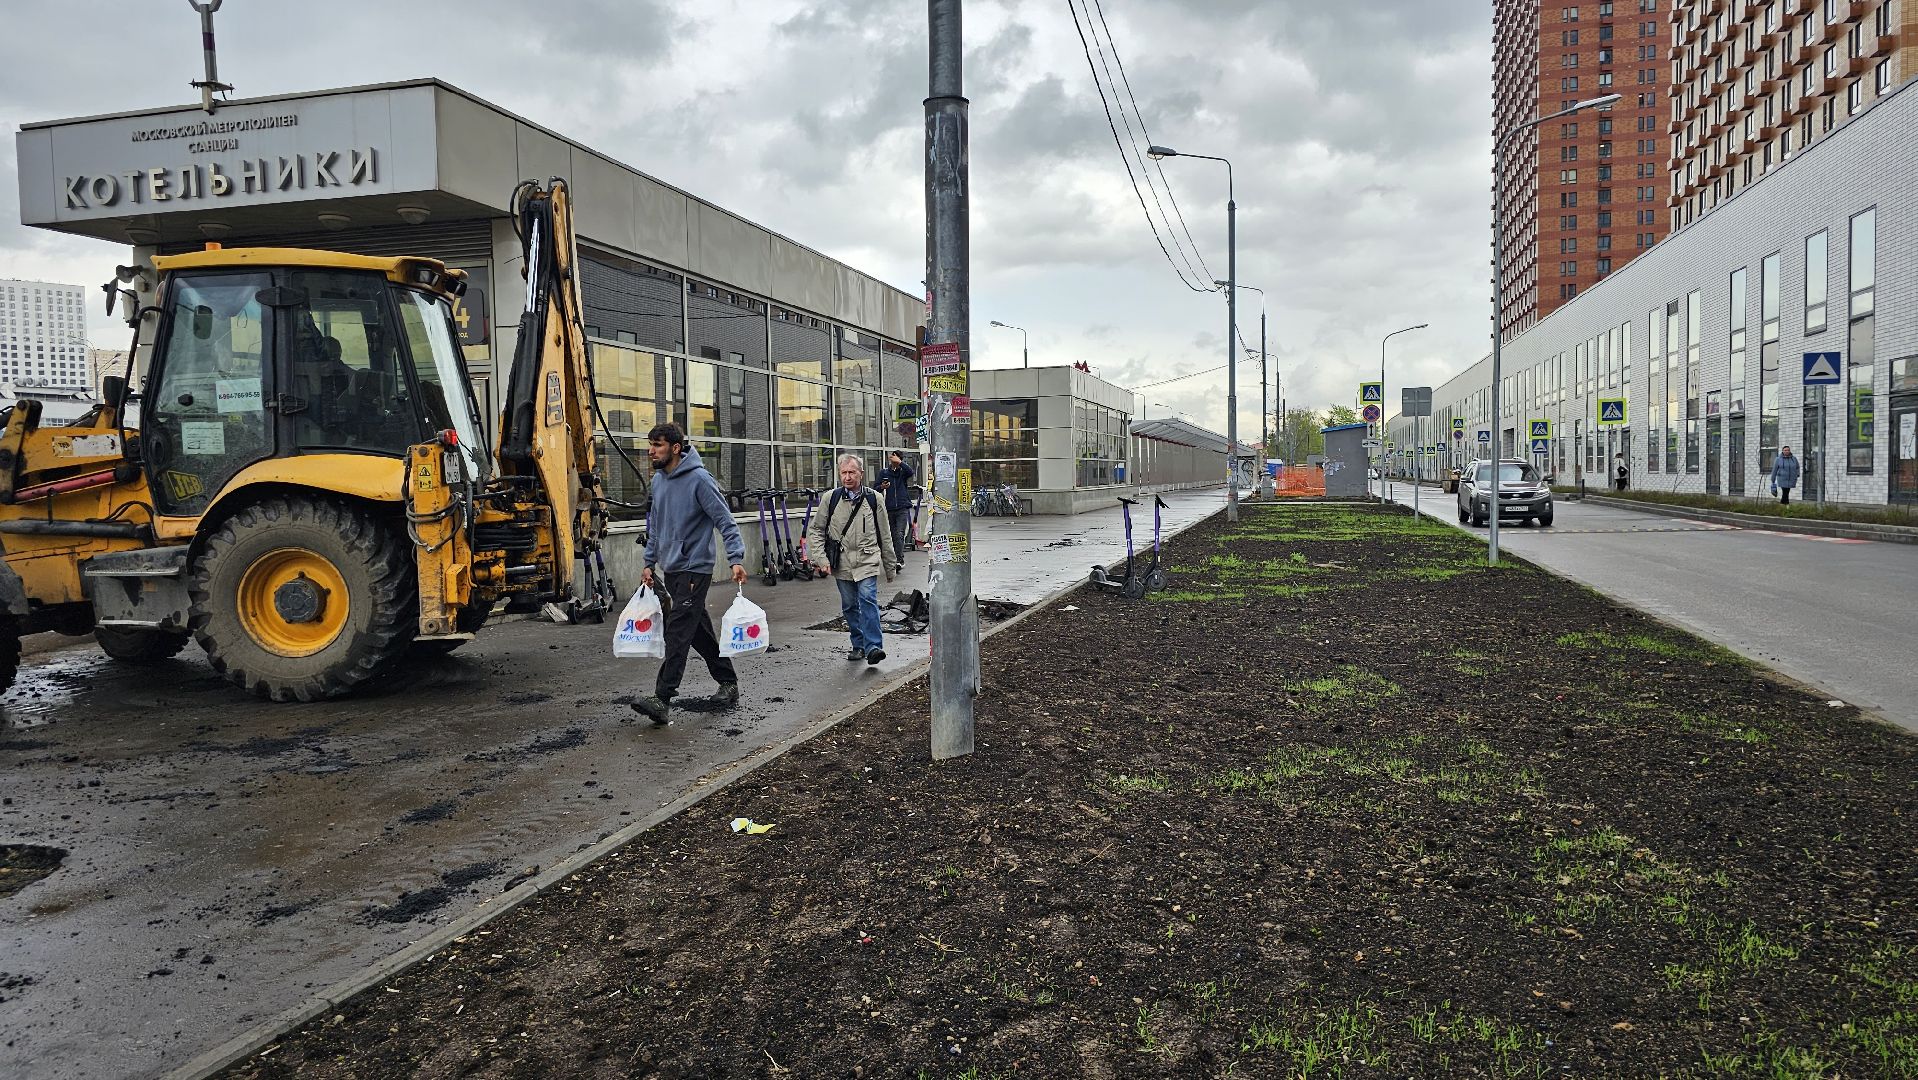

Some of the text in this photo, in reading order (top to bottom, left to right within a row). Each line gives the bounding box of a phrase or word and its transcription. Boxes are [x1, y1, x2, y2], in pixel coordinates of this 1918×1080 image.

[131, 114, 298, 142] МОСКОВСКИЙ МЕТРОПОЛИТЕН
[188, 138, 239, 154] СТАНЦИЯ
[64, 147, 379, 209] КОТЕЛЬНИКИ
[452, 297, 471, 329] 4
[174, 474, 201, 499] JCB
[622, 618, 634, 634] Я
[732, 626, 744, 642] Я
